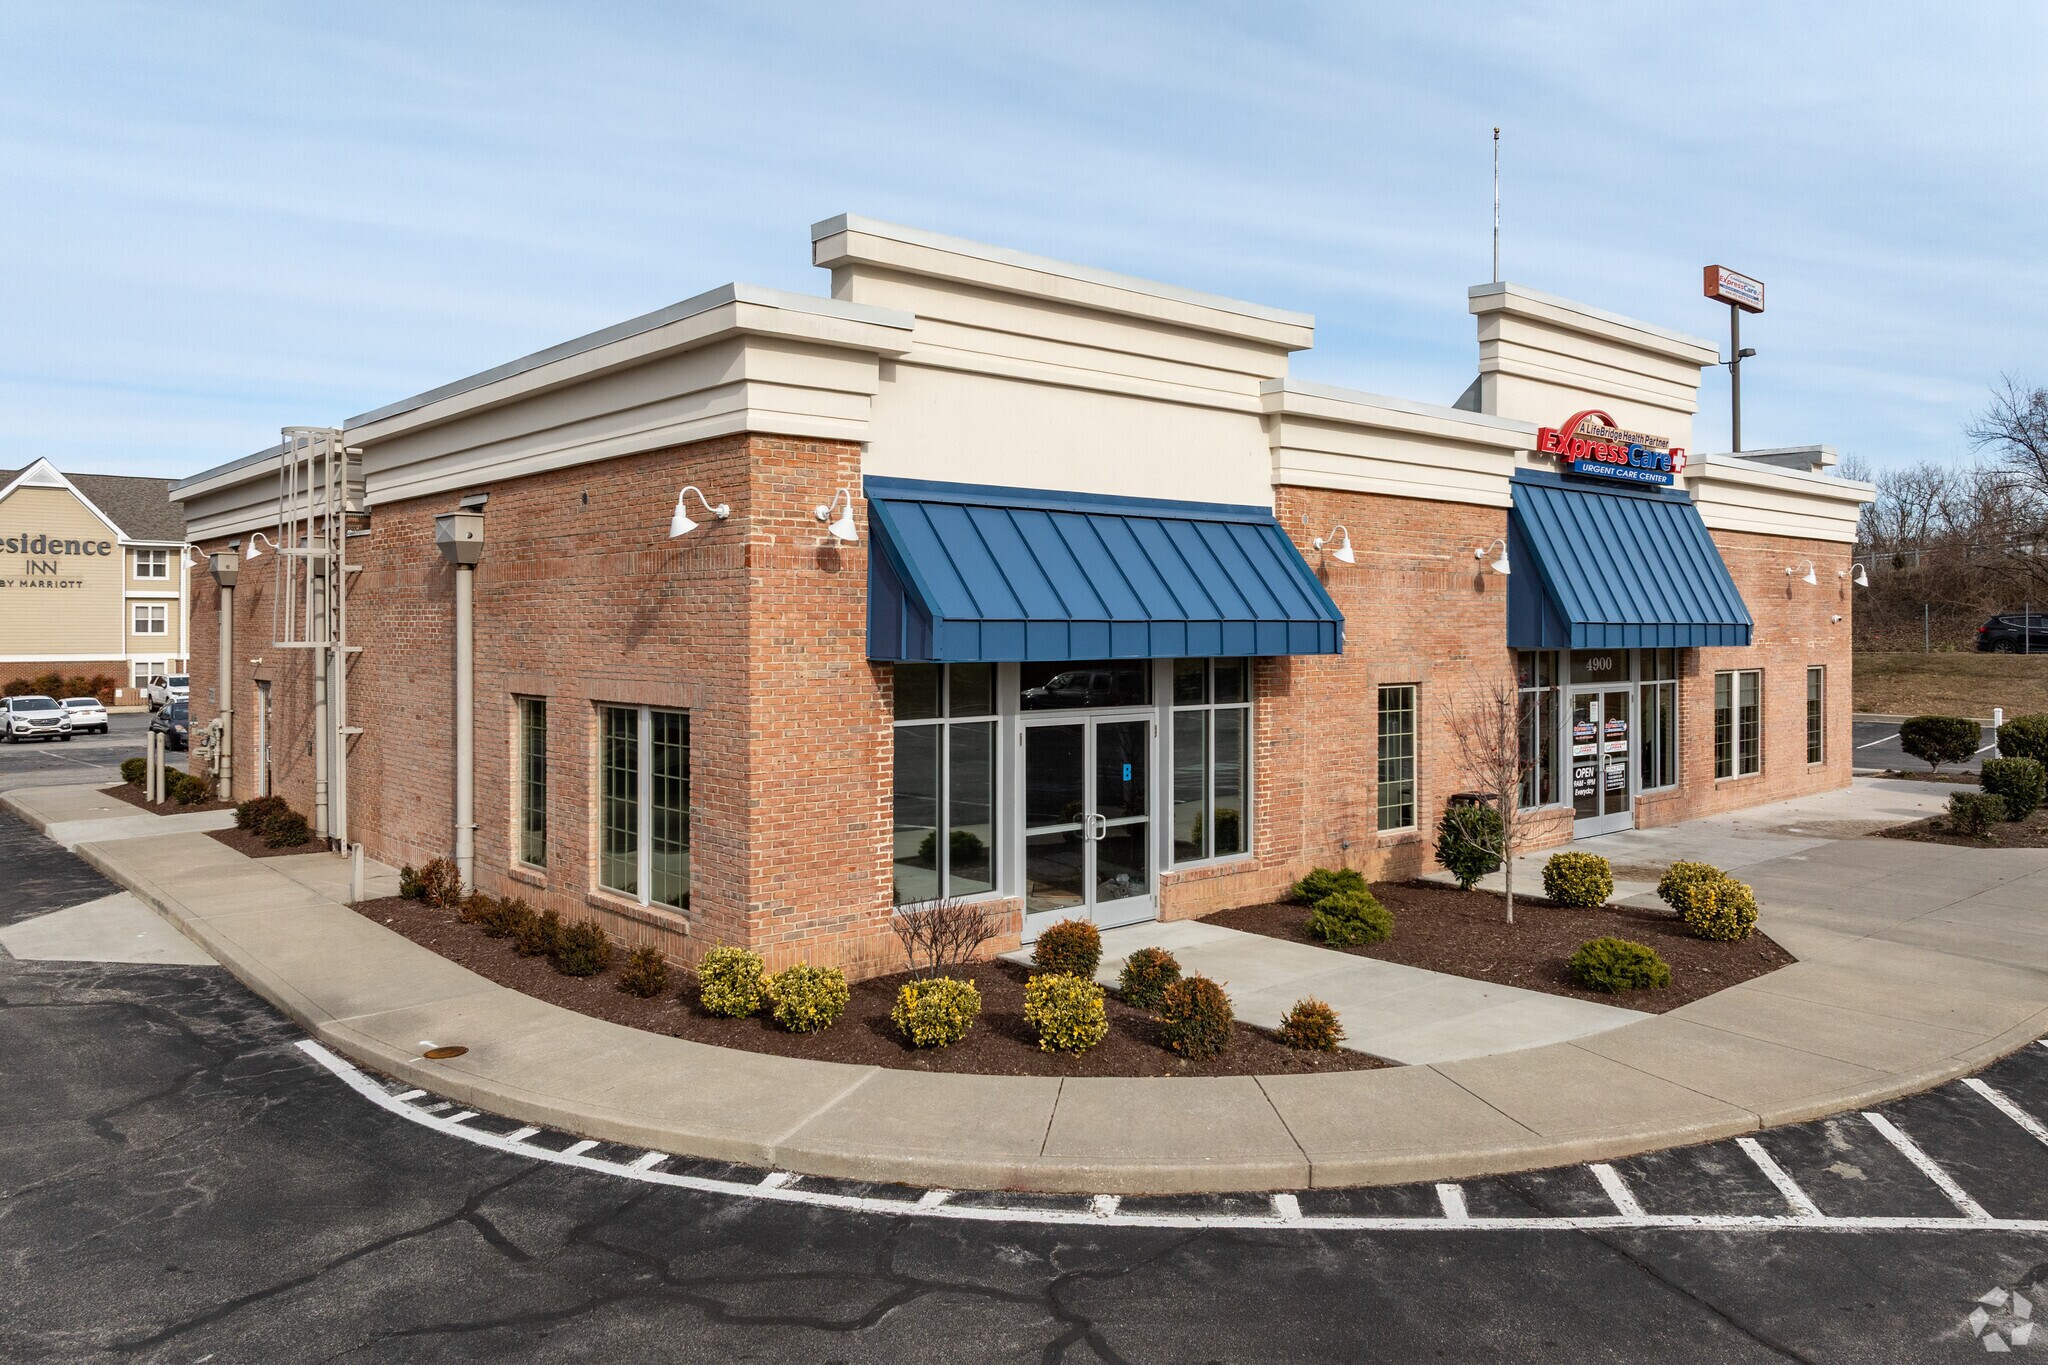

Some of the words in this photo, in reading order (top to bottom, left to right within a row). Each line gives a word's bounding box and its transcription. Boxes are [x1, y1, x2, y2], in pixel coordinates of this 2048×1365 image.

[1579, 422, 1585, 433] A
[1586, 423, 1623, 441] LifeBridge
[1622, 430, 1645, 444] Health
[1644, 435, 1669, 448] Partner
[1582, 463, 1616, 475] URGENT
[1616, 469, 1638, 479] CARE
[1639, 472, 1667, 483] CENTER
[26, 560, 57, 575] INN
[0, 580, 14, 588] BY
[19, 580, 83, 588] MARRIOTT
[1586, 656, 1612, 671] 4900
[1575, 767, 1595, 779] OPEN
[1574, 788, 1595, 796] Everyday
